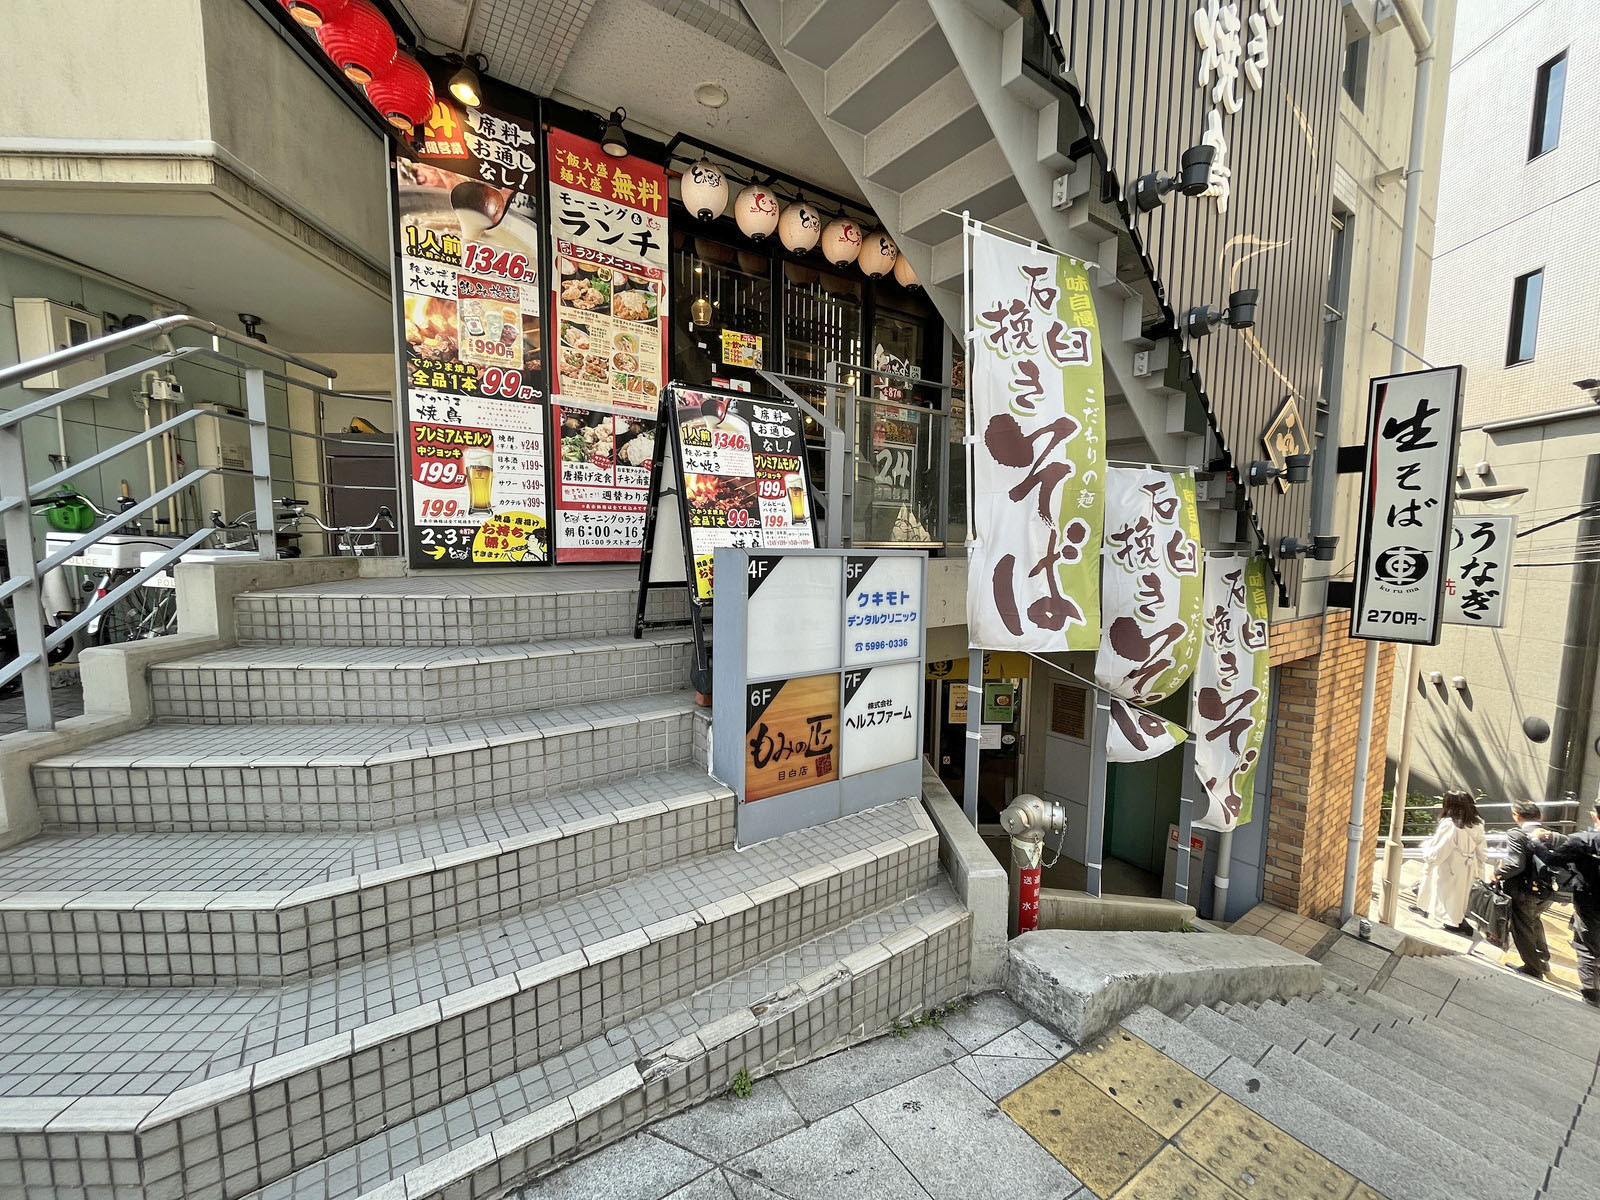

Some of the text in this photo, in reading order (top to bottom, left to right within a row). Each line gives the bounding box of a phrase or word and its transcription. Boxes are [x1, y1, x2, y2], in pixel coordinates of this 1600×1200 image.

[479, 115, 521, 148] 席料
[474, 138, 534, 169] お通し
[554, 147, 609, 179] ご飯大盛
[559, 165, 603, 194] 麺大盛
[610, 166, 663, 213] 無料
[557, 209, 661, 257] ランチ
[575, 247, 642, 272] ランチメニュー
[1065, 276, 1096, 329] 味自慢
[474, 339, 515, 359] 990円
[411, 357, 477, 375] でかうま焼鳥
[411, 368, 478, 392] 全品1本
[415, 405, 462, 424] 焼鳥
[760, 409, 783, 422] 席料
[414, 425, 494, 447] プレミアムモルツ
[497, 434, 515, 442] 焼酎
[682, 426, 711, 443] 1人前
[758, 424, 790, 437] お通し
[416, 445, 462, 459] 中ジョッキ
[1076, 387, 1101, 509] こだわりの麺
[496, 455, 519, 464] 日本酒
[685, 457, 721, 474] 水炊き
[753, 455, 801, 472] プレミアムモルツ
[873, 448, 911, 488] 24
[1381, 398, 1441, 529] 生そば
[418, 461, 467, 484] 199円
[562, 470, 613, 484] 唐揚げ定食
[498, 479, 519, 487] サワー
[758, 480, 786, 498] 199円
[420, 498, 466, 518] 199円
[498, 499, 521, 507] カクテル
[692, 514, 726, 528] 全品1本
[763, 514, 789, 528] 199円
[481, 523, 524, 539] お持ち
[484, 535, 510, 550] 帰り
[68, 557, 98, 566] OLICE
[747, 560, 769, 579] 4F
[846, 562, 864, 579] 5F
[1459, 521, 1501, 621] うなぎ
[857, 591, 910, 608] クキモト
[847, 611, 917, 628] デンタルクリニック
[865, 638, 909, 651] 5996-0336
[844, 671, 862, 689] 7F
[750, 687, 772, 708] 6F
[867, 698, 893, 710] 株式会社
[845, 705, 913, 732] ヘルスファーム
[749, 713, 833, 770] もみの匠
[777, 765, 809, 781] 目白店
